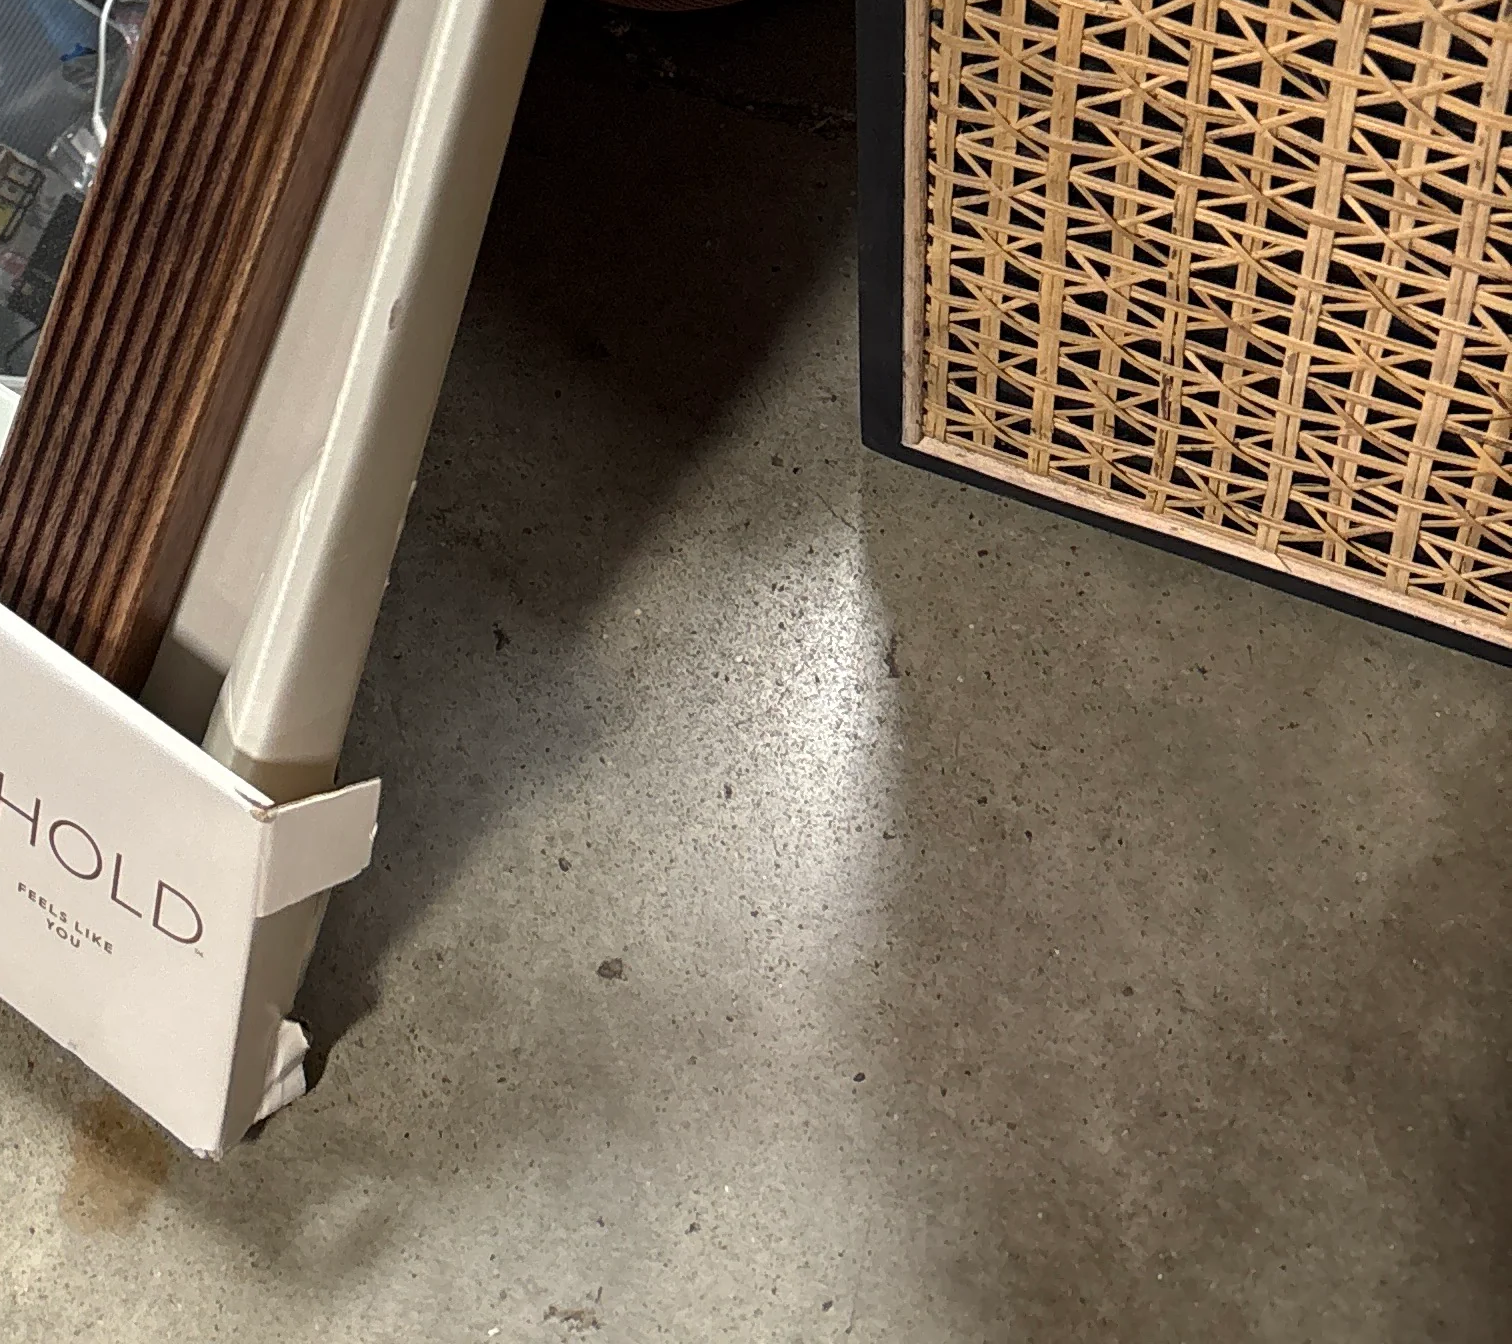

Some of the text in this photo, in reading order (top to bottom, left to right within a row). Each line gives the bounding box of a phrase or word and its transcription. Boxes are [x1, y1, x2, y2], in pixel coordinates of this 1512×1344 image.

[17, 881, 114, 954] FEELS LIKE
[45, 918, 81, 950] YOU
